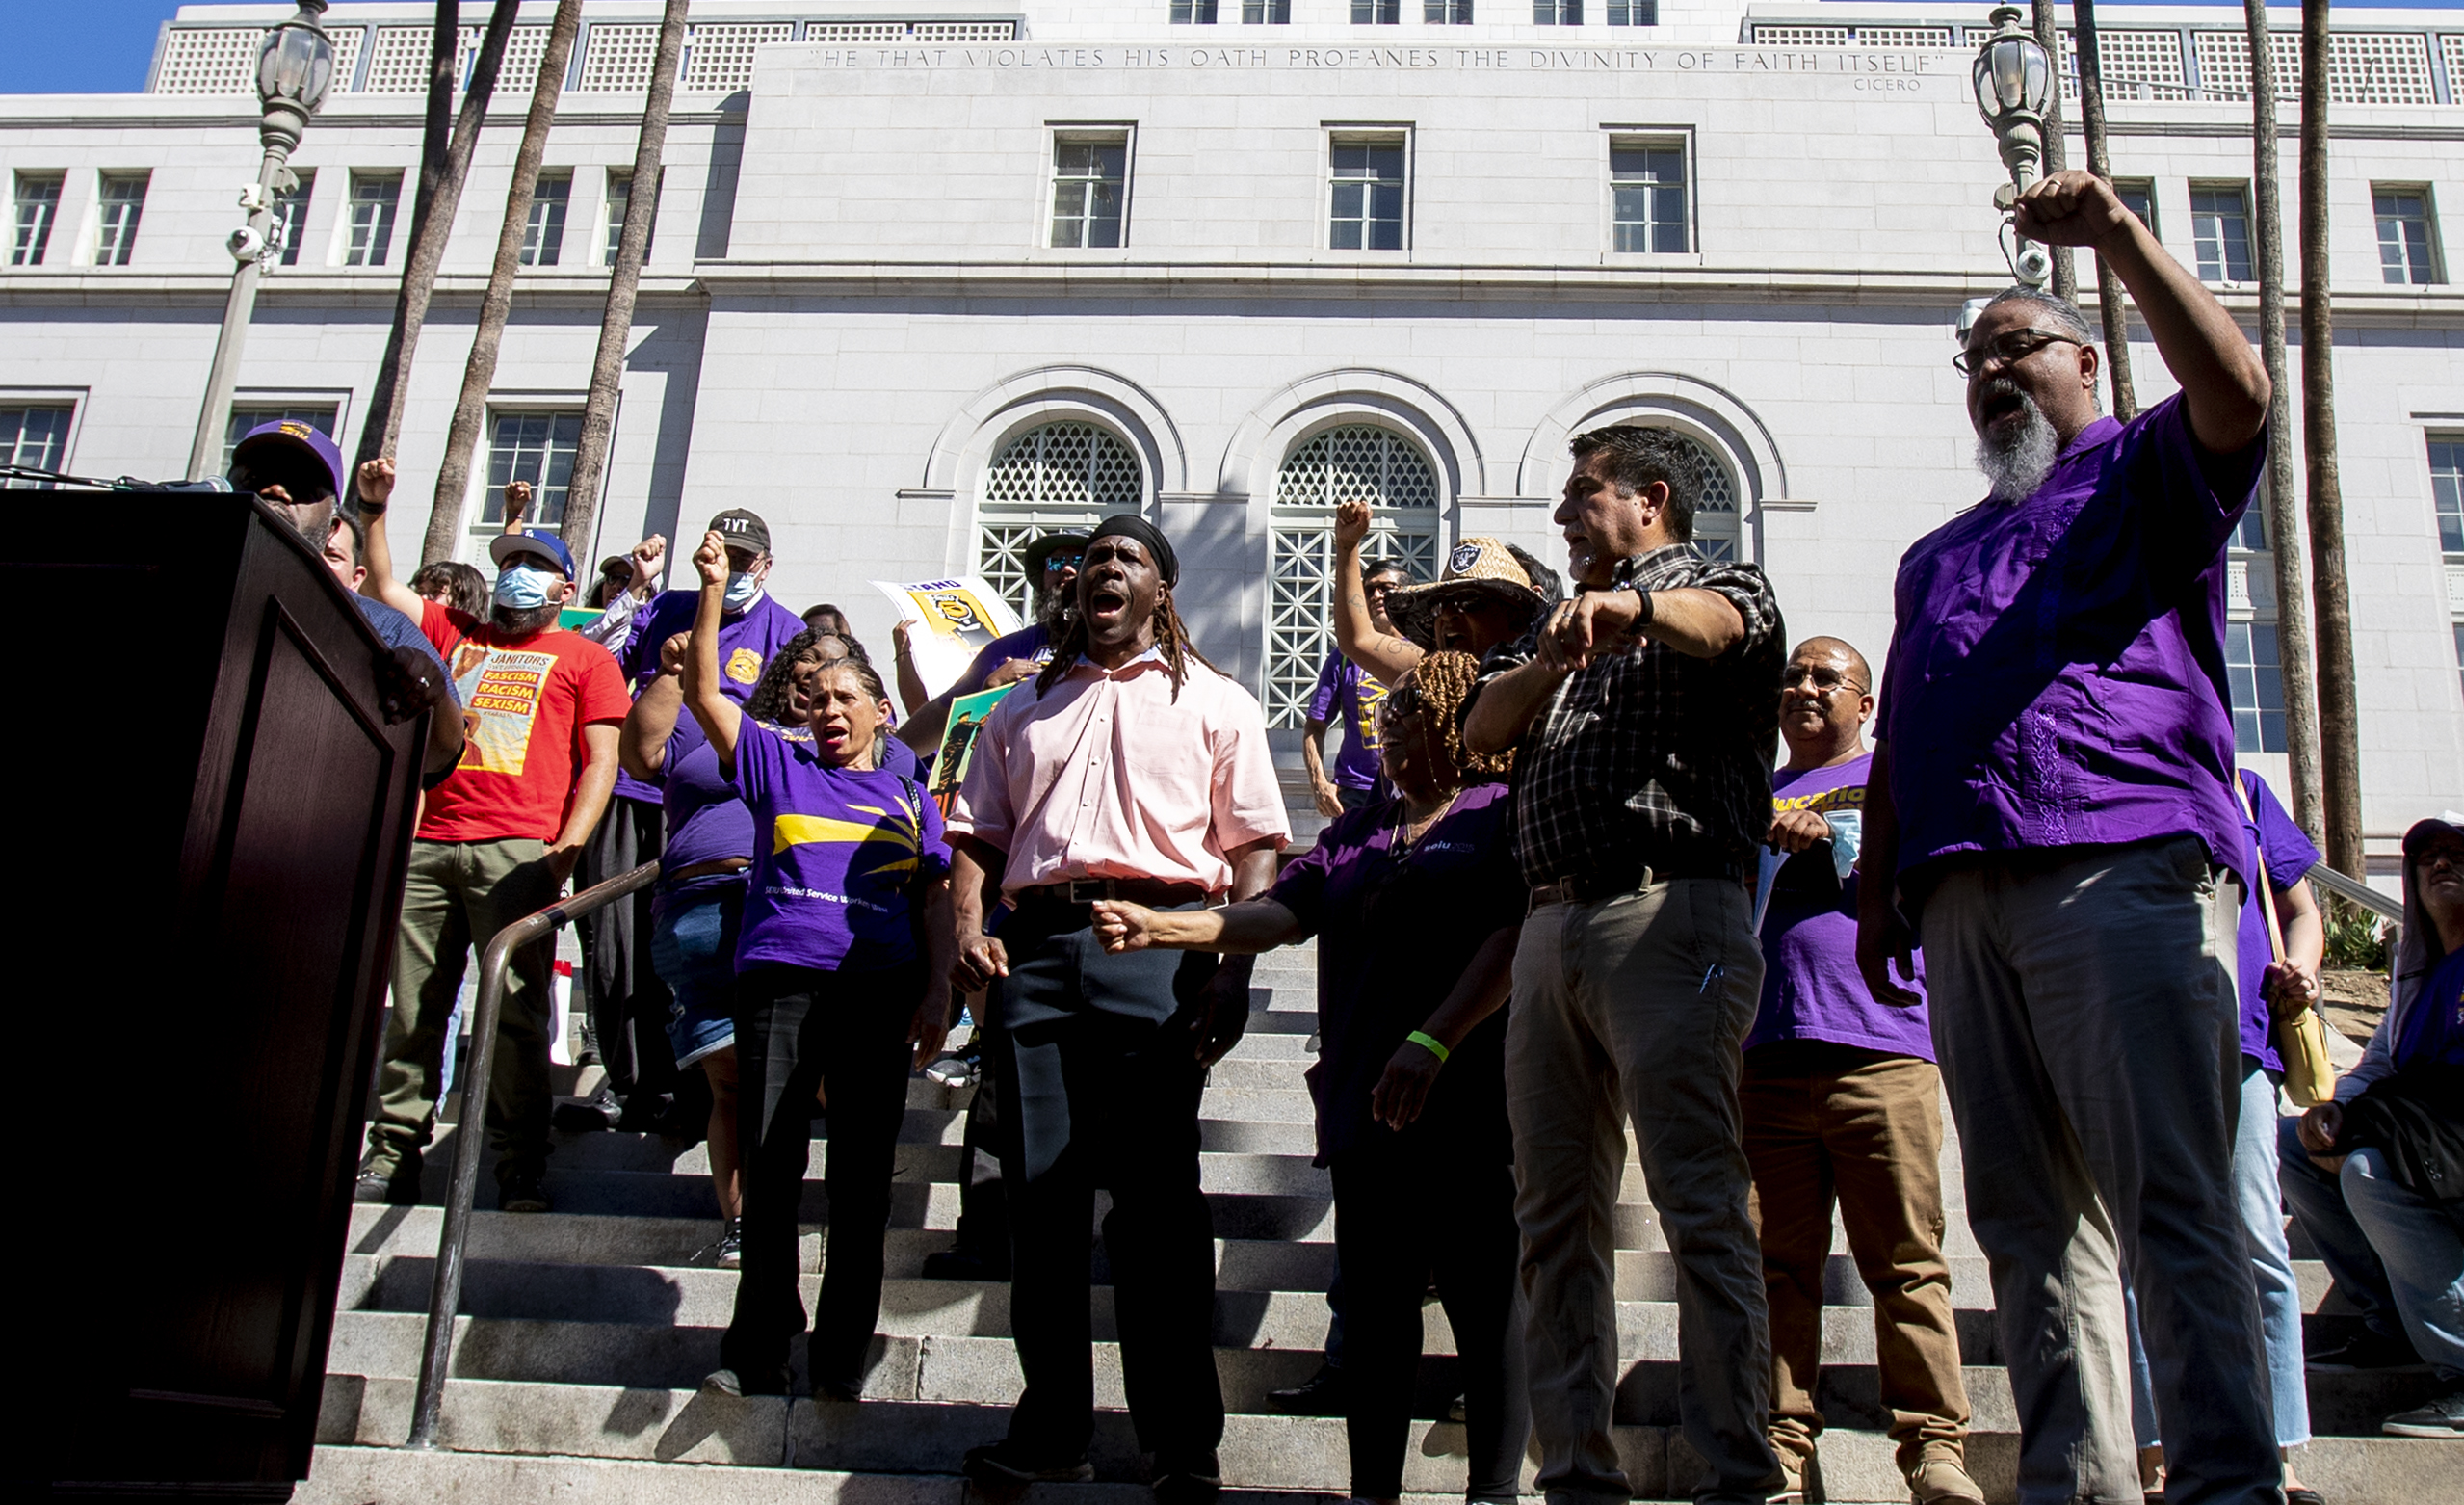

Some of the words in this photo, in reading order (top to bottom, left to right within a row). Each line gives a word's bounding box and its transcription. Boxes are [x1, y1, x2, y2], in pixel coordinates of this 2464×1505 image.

[877, 50, 946, 66] THAT
[965, 49, 1103, 66] VIOLATES
[1125, 49, 1168, 66] HIS
[1191, 49, 1266, 66] OATH
[1289, 49, 1437, 67] PROFANES
[1456, 50, 1508, 67] THE
[1530, 51, 1658, 69] DIVINITY
[1678, 52, 1714, 69] OF
[1734, 53, 1818, 70] FAITH
[1853, 78, 1921, 92] CICERO
[723, 517, 749, 533] TYT
[491, 653, 549, 666] JANITORS
[484, 671, 538, 683] FASCISM
[478, 682, 534, 700] RACISM
[473, 697, 529, 714] SEXISM
[1773, 785, 1866, 811] ucatio
[806, 888, 839, 903] Service
